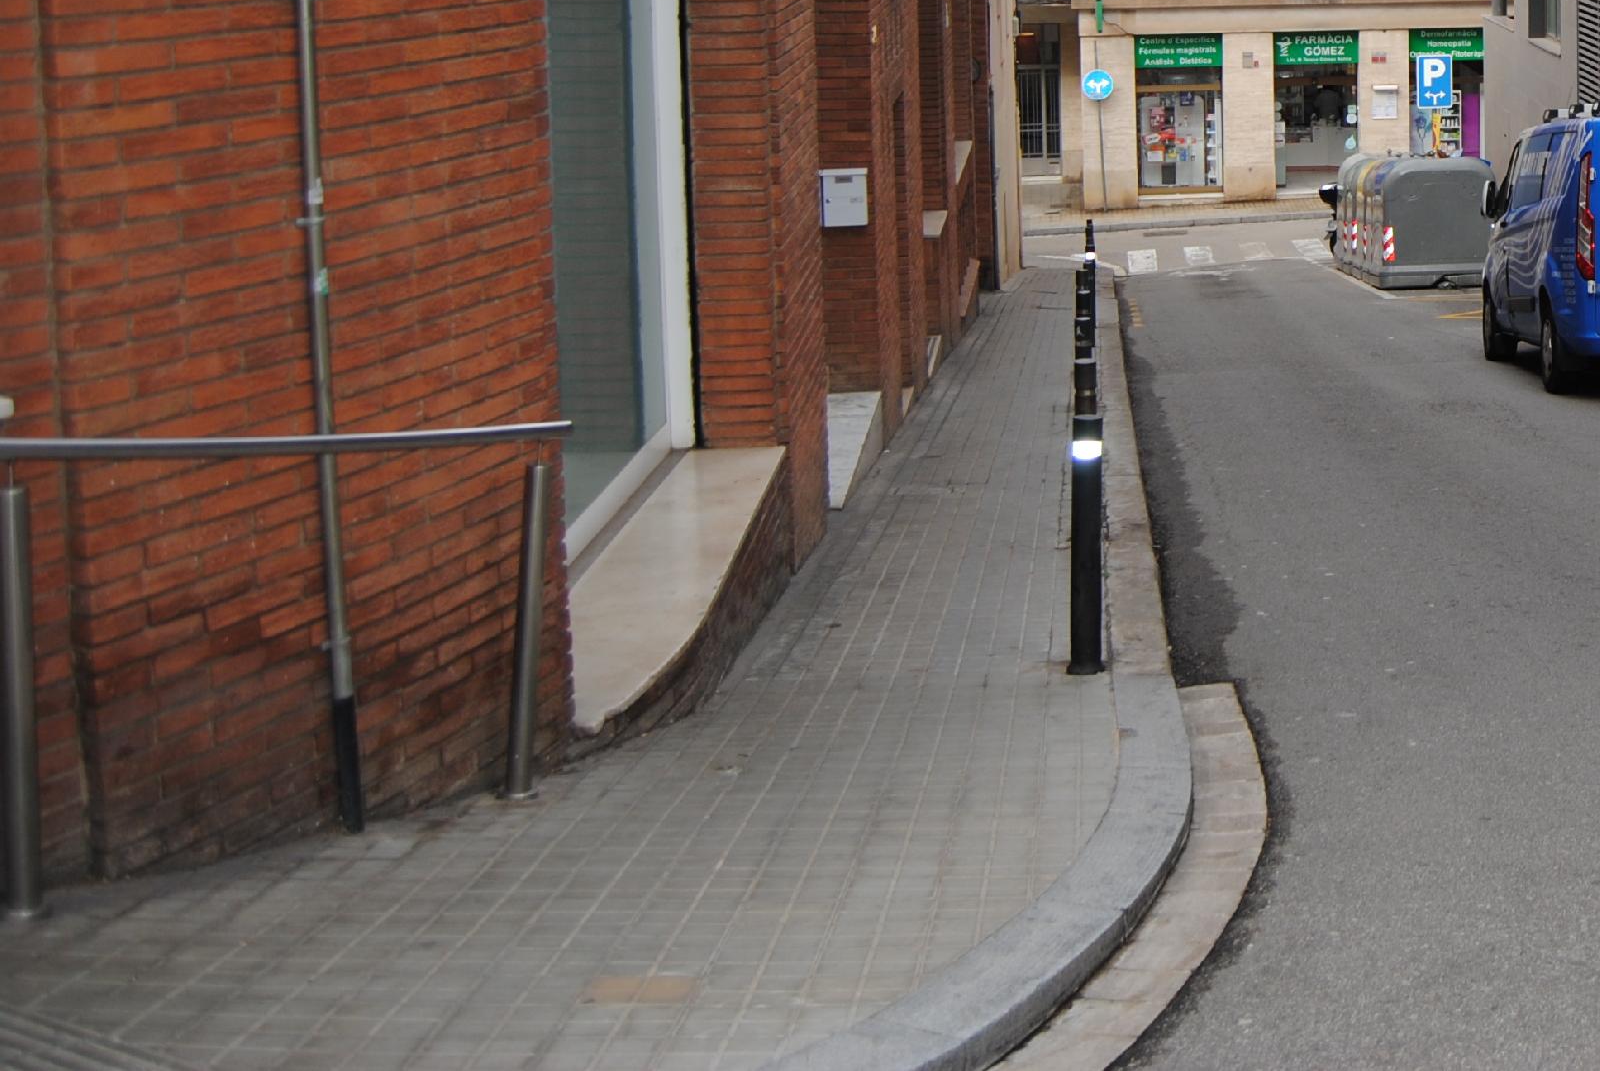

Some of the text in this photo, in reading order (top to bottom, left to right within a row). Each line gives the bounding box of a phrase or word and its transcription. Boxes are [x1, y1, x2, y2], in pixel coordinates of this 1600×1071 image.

[1295, 34, 1353, 44] FARMÀCIA
[1303, 46, 1345, 56] GÓMEZ
[1423, 58, 1446, 87] P
